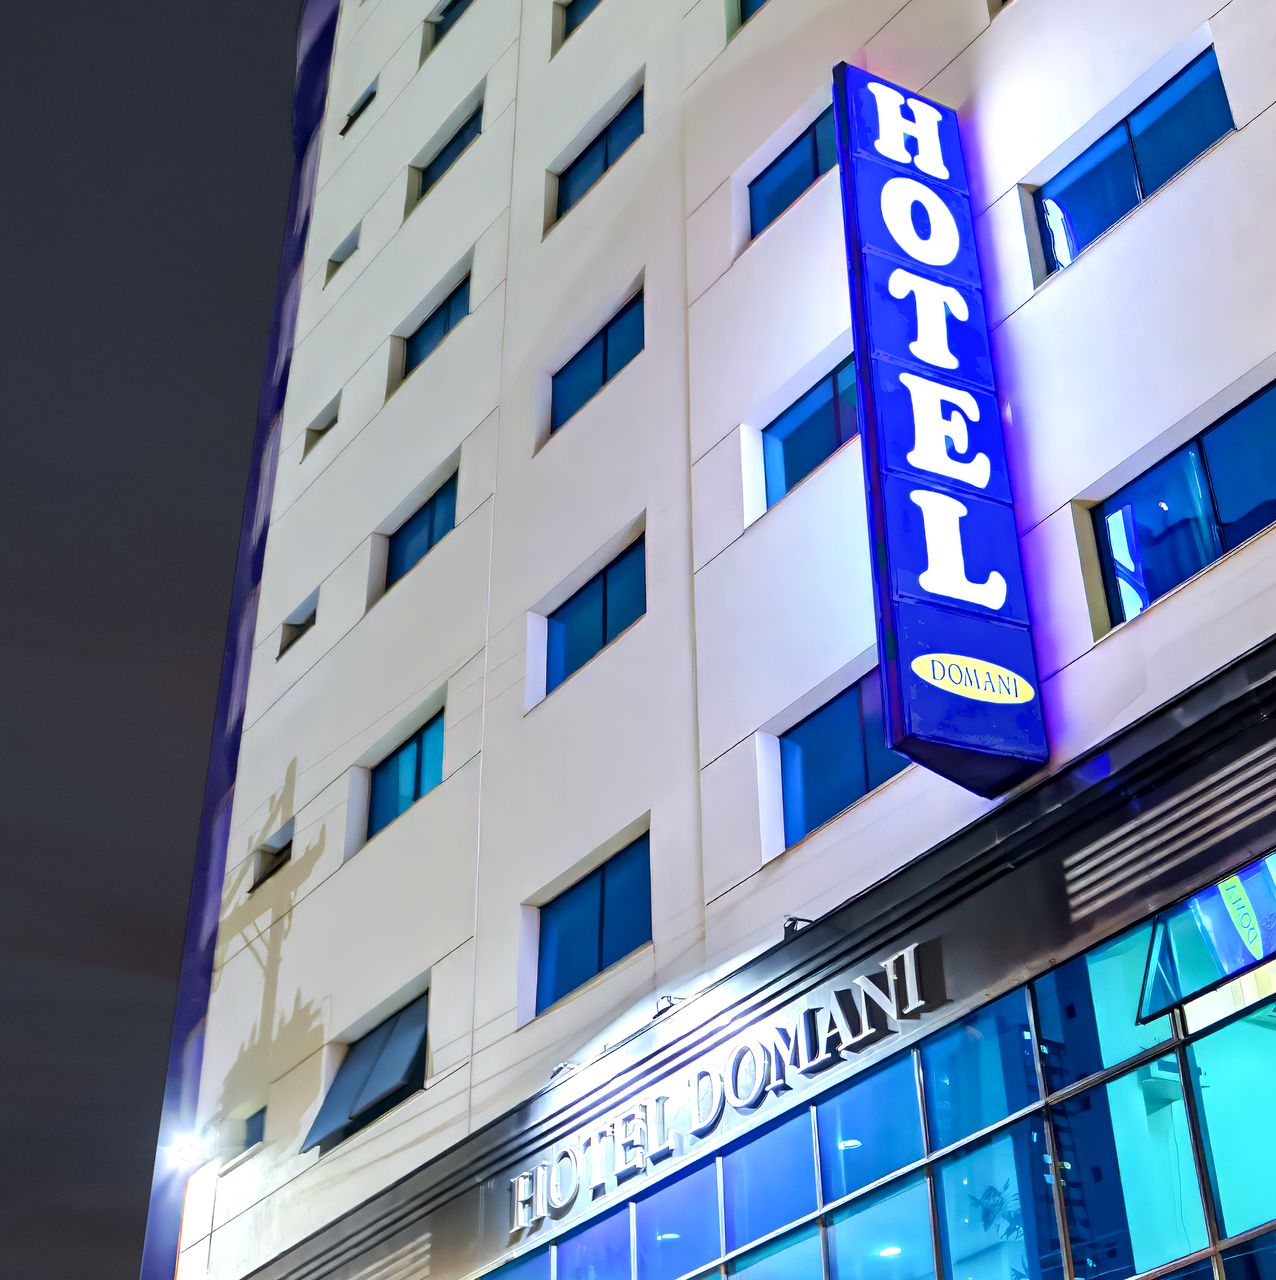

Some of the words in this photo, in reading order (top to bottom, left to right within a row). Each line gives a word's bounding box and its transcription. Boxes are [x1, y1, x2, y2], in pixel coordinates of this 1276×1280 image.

[867, 81, 1007, 611] HOTEL
[931, 659, 1018, 698] DOMANI
[509, 1096, 676, 1233] HOTEL
[689, 942, 925, 1136] DOMANI
